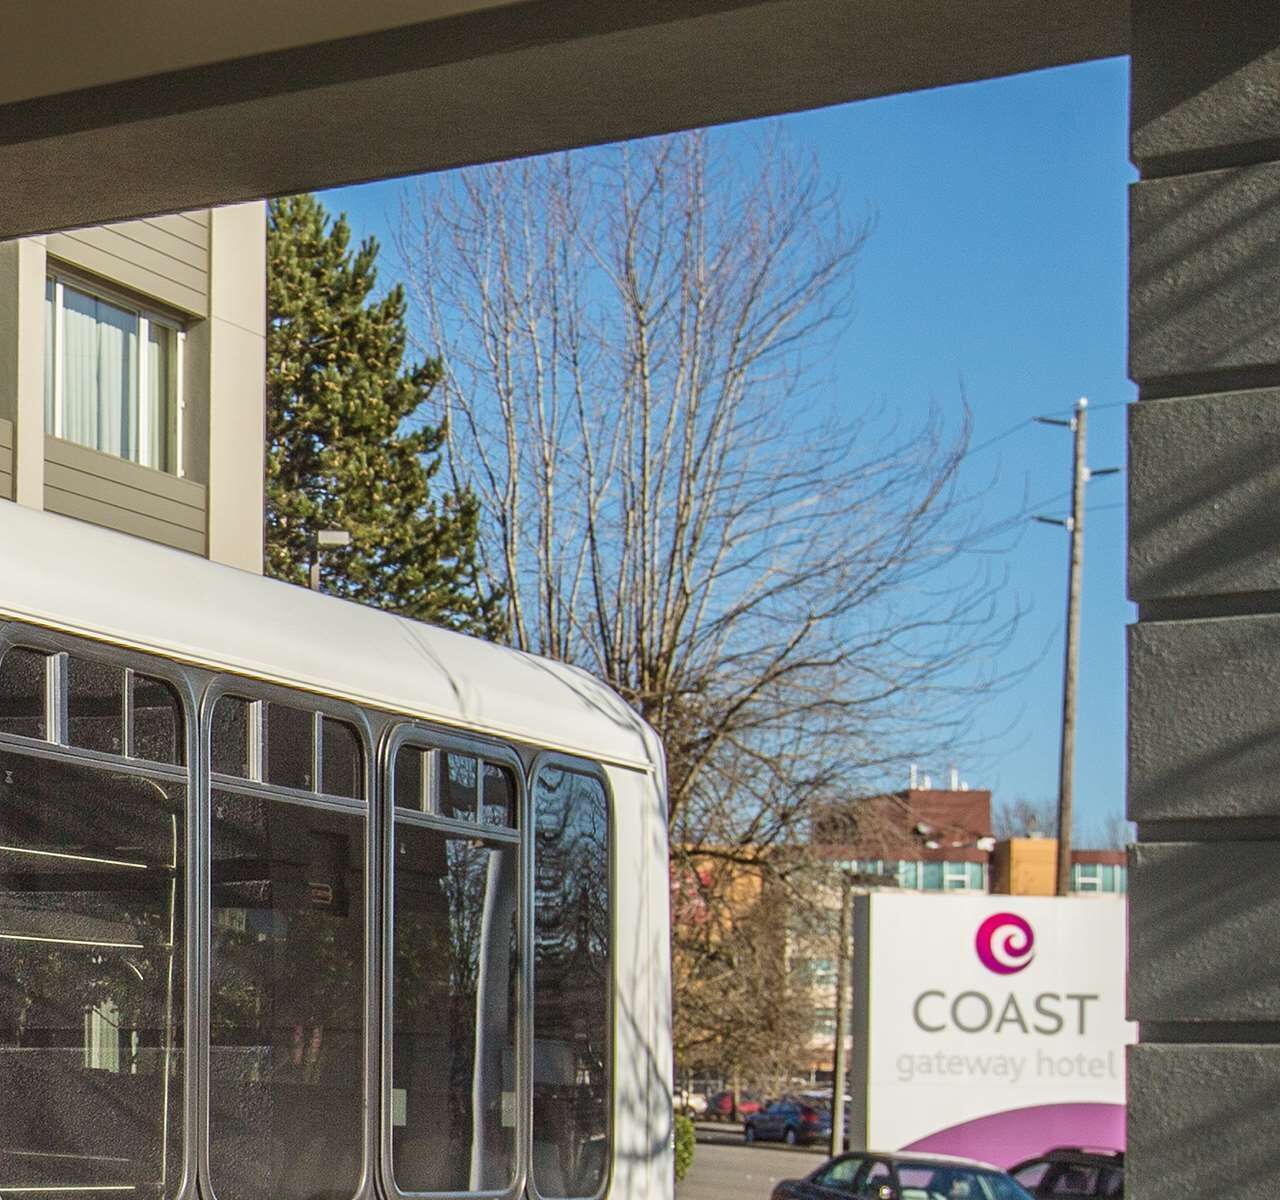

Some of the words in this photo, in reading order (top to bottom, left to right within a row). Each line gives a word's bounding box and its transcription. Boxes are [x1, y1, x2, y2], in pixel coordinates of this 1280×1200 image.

[912, 989, 1100, 1036] COAST
[894, 1050, 1026, 1083] gateway
[1037, 1048, 1118, 1079] hotel
